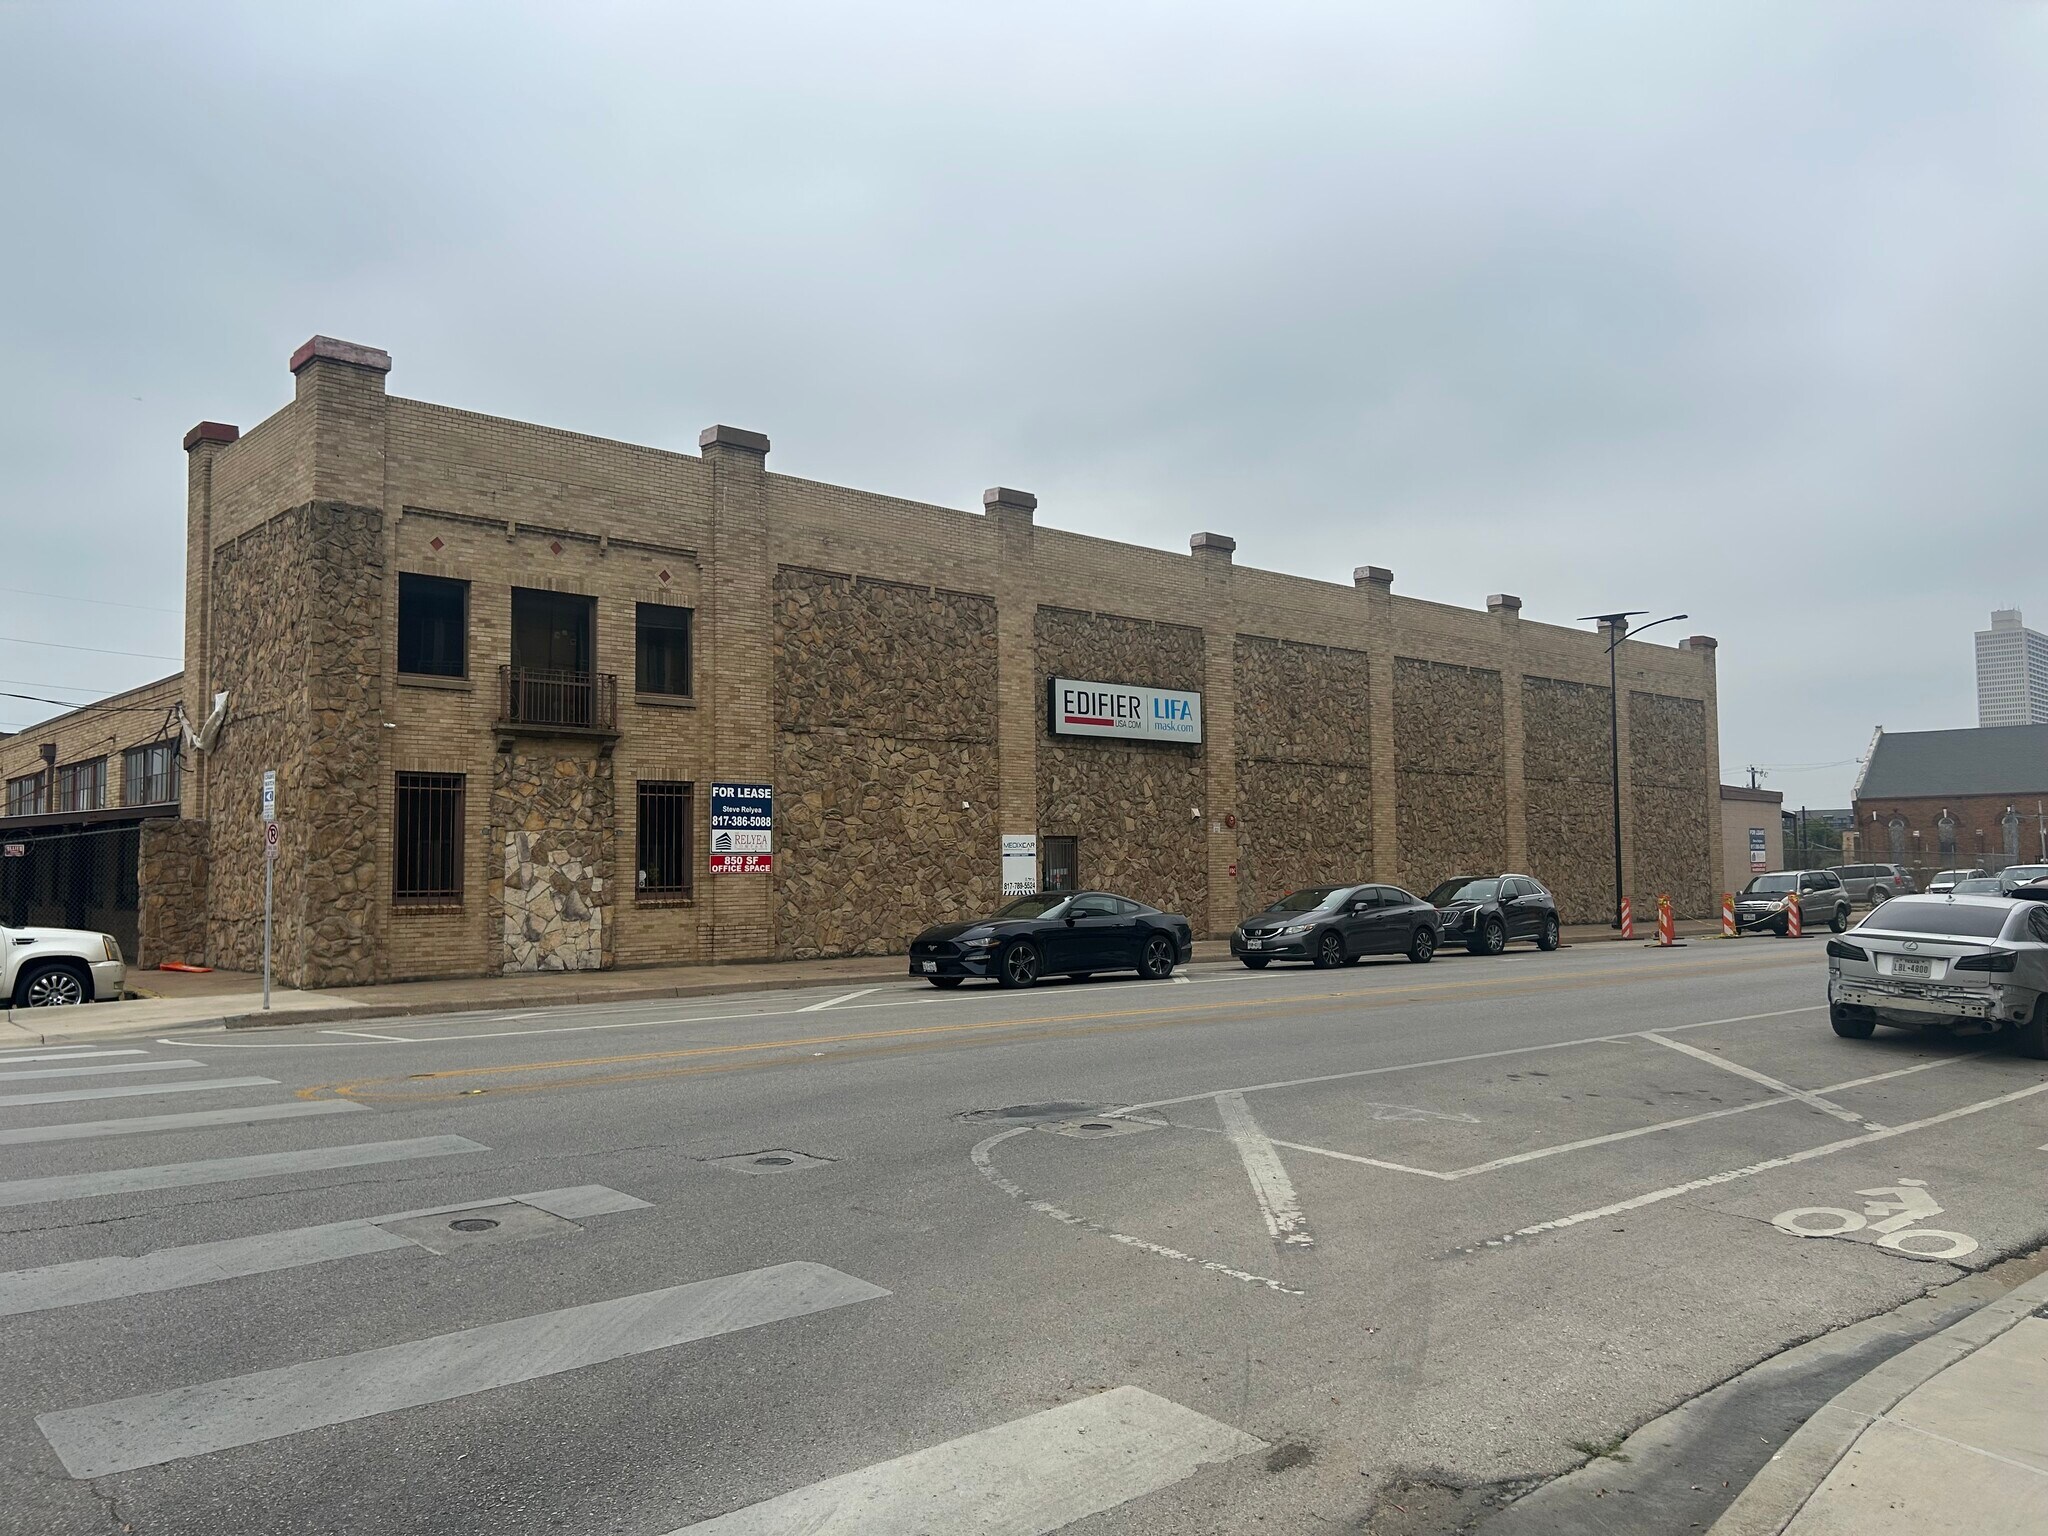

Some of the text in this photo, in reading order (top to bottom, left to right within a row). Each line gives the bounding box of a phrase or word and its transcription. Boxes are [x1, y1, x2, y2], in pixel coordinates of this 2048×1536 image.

[1064, 689, 1141, 719] EDIFIER
[1153, 697, 1193, 721] LIFA
[1115, 719, 1142, 729] USA.COM
[1154, 721, 1194, 733] mask.com
[712, 787, 772, 799] FOR LEASE
[722, 805, 762, 814] Steve Relyea
[712, 815, 771, 827] 817-386-5088
[734, 834, 768, 845] RELYEA
[724, 856, 759, 865] 850 SF
[712, 864, 771, 872] OFFICE SPACE
